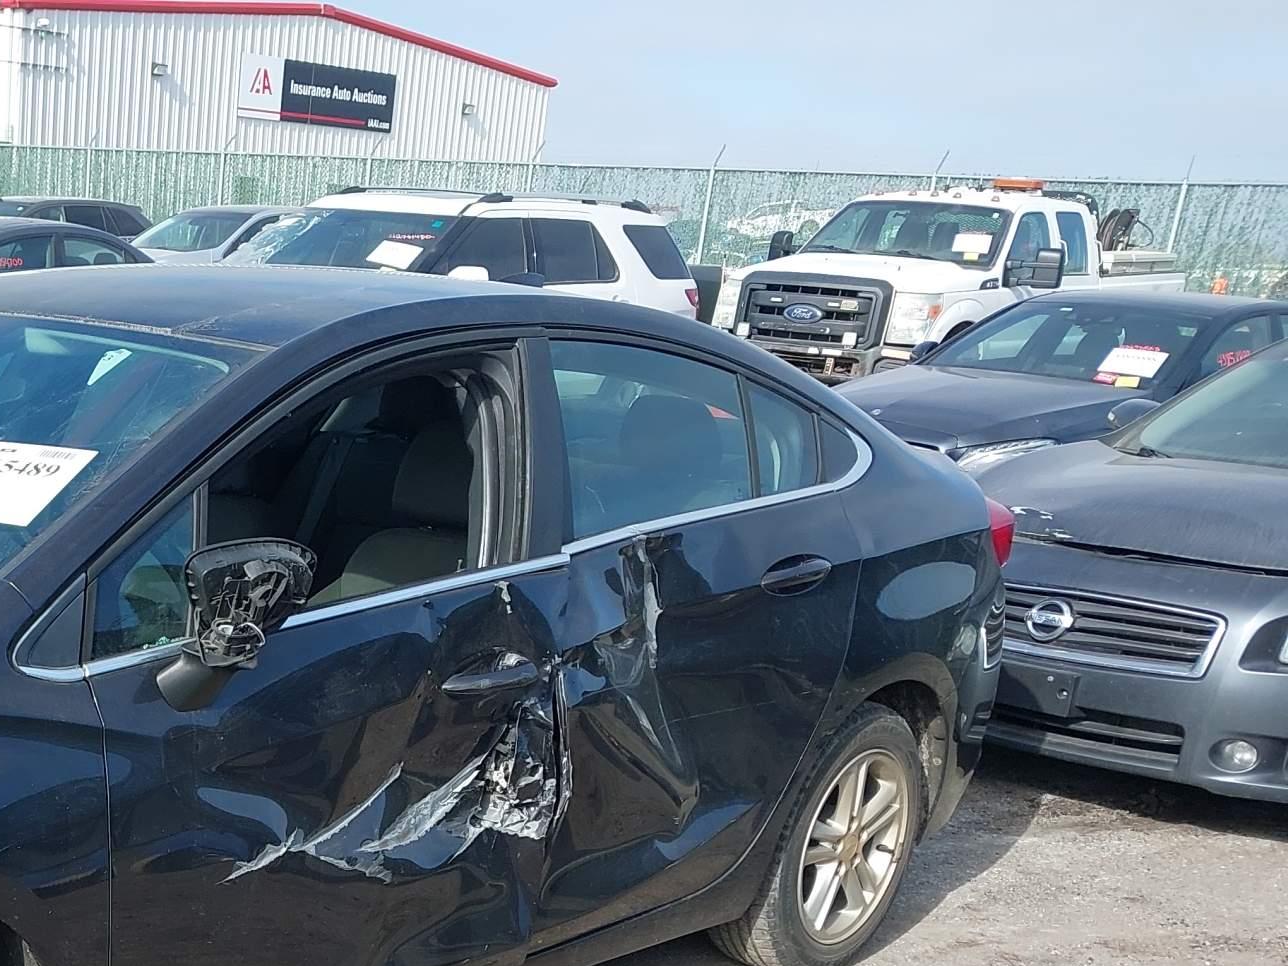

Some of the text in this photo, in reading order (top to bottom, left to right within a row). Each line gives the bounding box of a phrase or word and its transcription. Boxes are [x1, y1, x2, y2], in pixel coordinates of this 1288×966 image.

[290, 80, 387, 106] Insurance Auto Auctions
[791, 307, 813, 319] Ford
[1025, 611, 1064, 626] NISSAN
